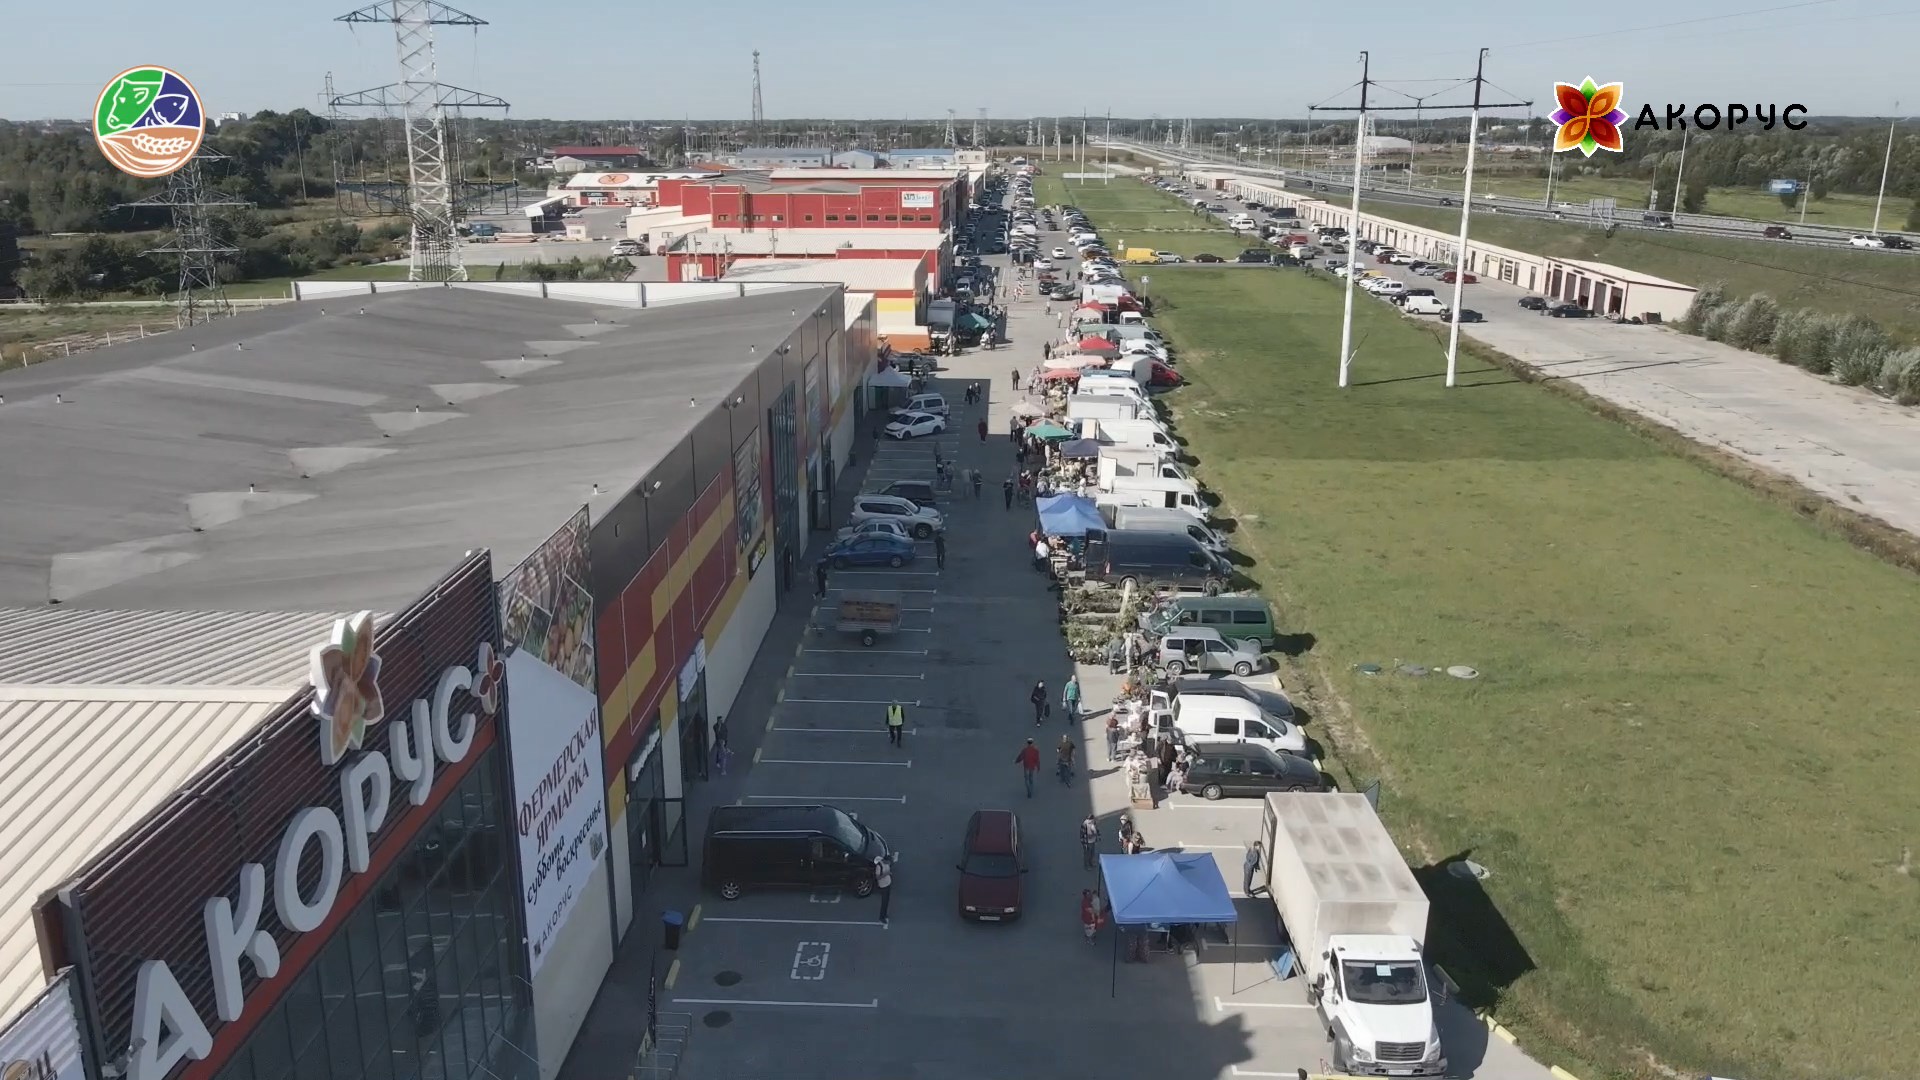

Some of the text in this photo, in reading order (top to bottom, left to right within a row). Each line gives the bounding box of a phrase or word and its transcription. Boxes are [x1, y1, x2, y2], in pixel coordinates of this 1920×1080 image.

[519, 706, 597, 838] ФЕРМЕРСКАЯ
[536, 757, 590, 854] ЯРМАРКА
[126, 664, 476, 1080] АКОРУС
[527, 835, 565, 906] суббота
[542, 884, 573, 945] АКОРУС
